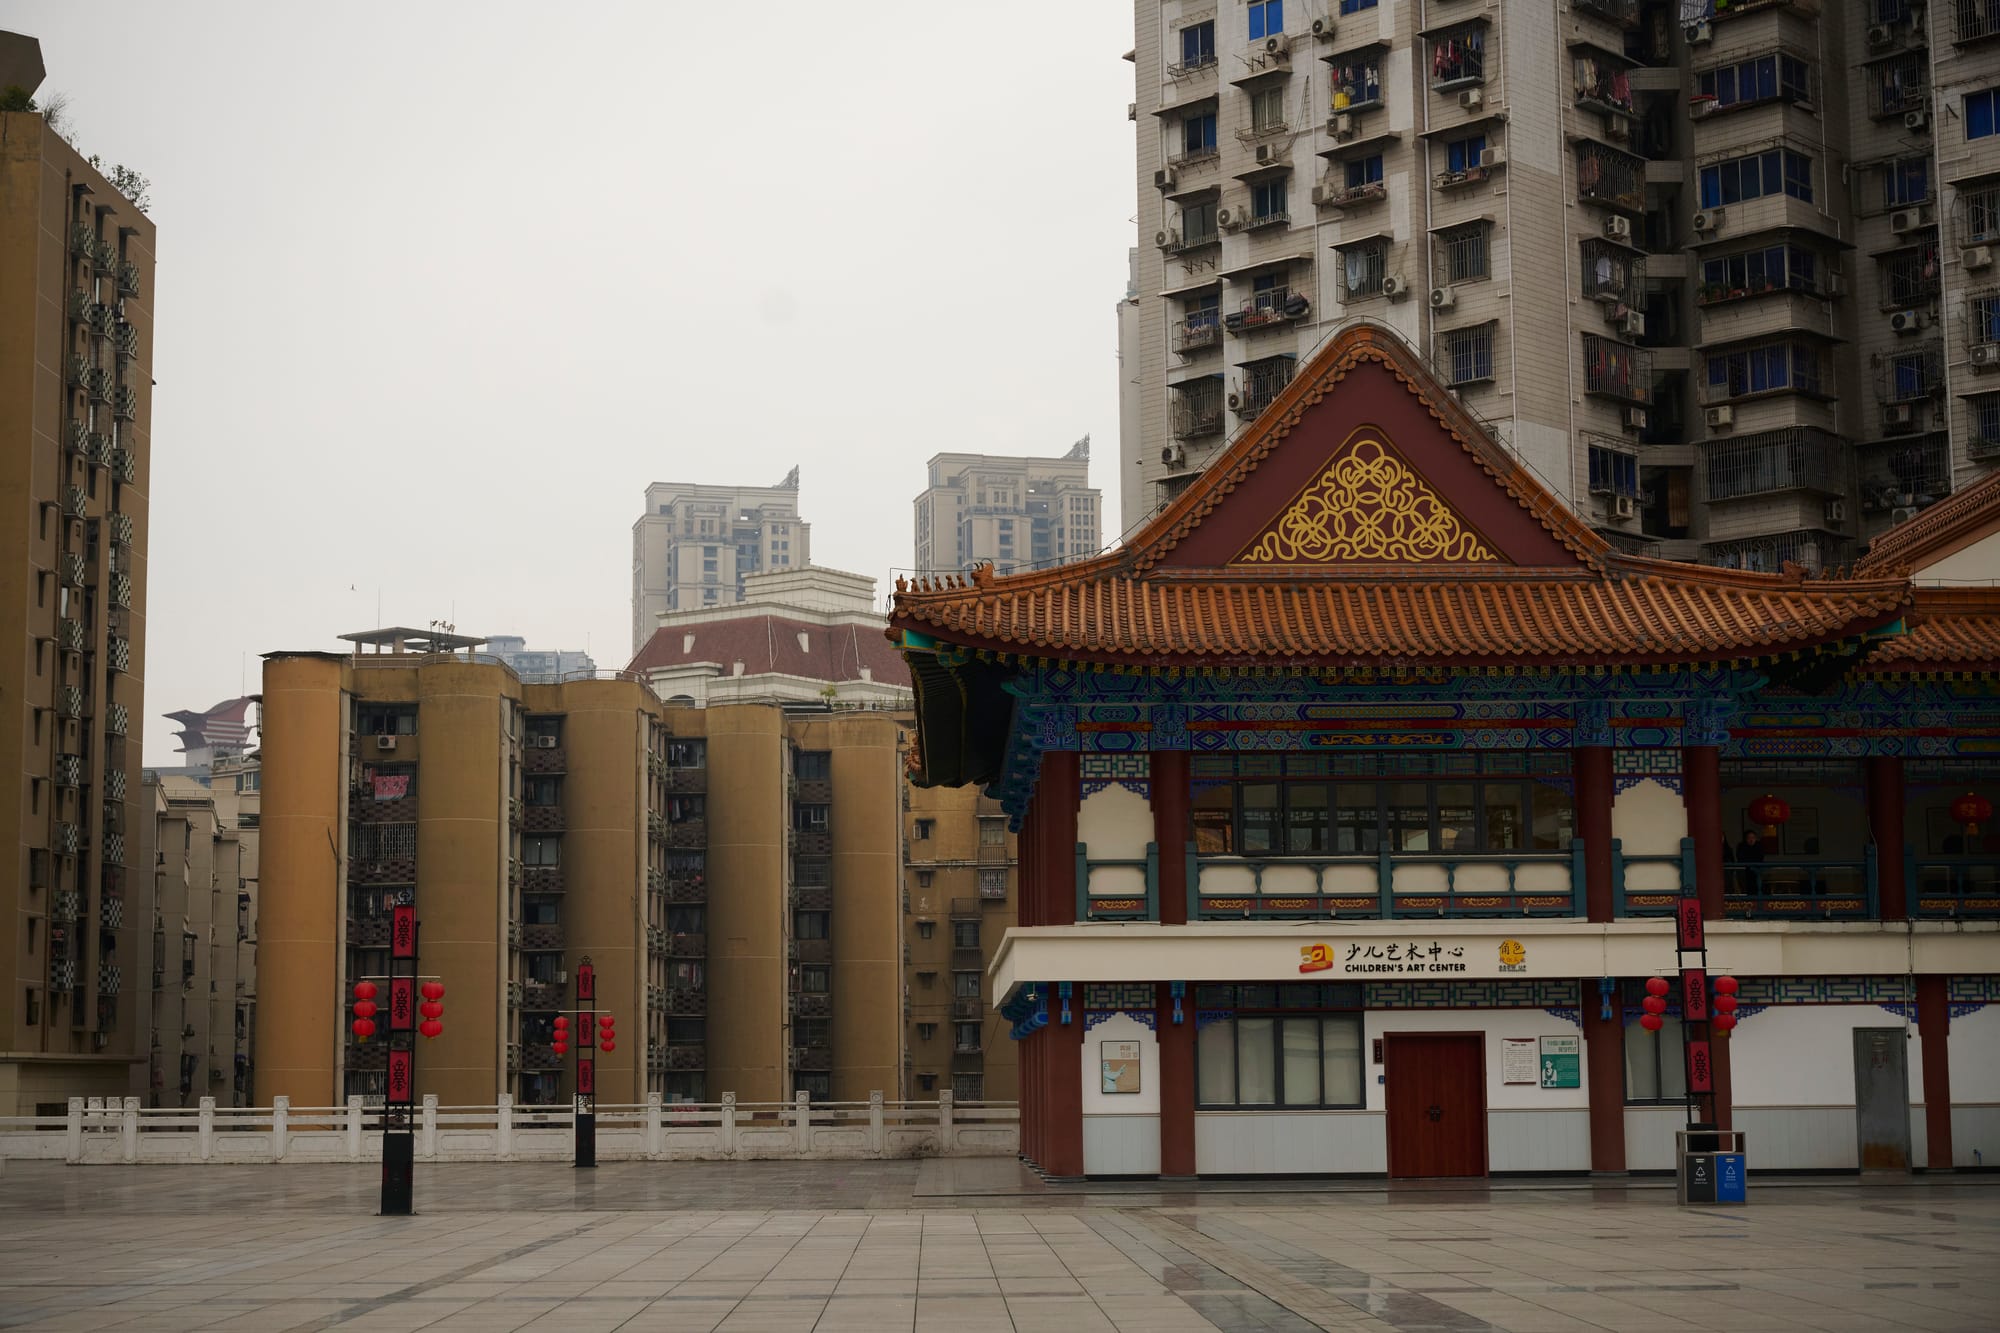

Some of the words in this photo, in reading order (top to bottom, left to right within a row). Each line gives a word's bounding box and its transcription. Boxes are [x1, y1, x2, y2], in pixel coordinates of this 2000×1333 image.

[1345, 941, 1465, 961] 少儿艺术中心
[1345, 963, 1404, 973] CHILDREN'S
[1407, 963, 1425, 972] ART
[1429, 963, 1466, 972] CENTER
